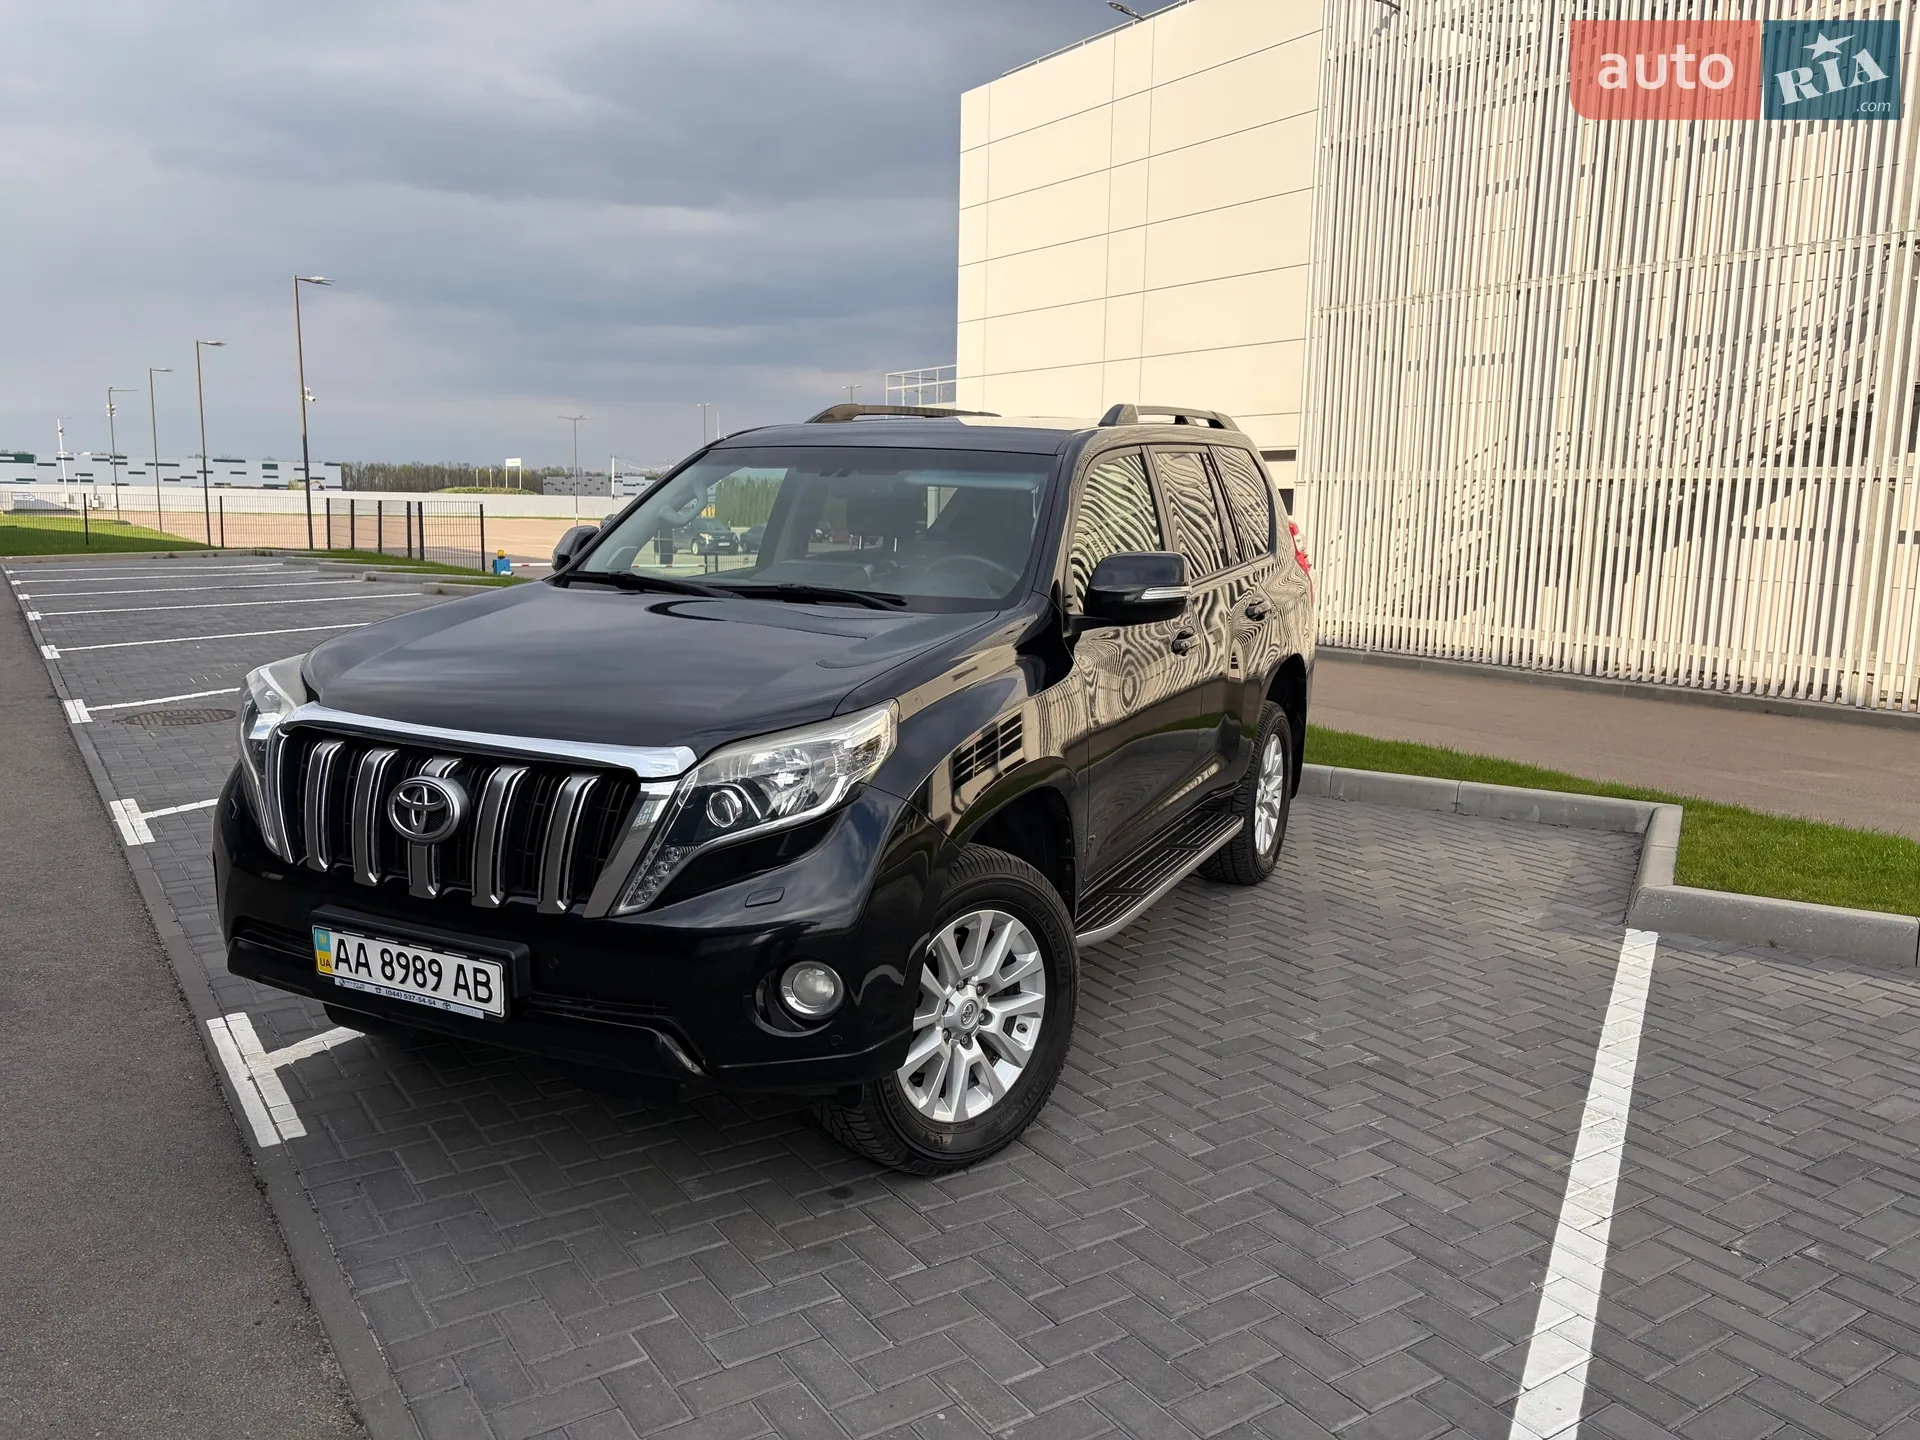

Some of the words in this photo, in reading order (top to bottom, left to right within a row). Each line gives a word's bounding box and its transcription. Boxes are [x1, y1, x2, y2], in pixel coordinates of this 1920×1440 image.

[319, 957, 332, 969] UA
[334, 938, 373, 978] AA
[380, 947, 443, 992] 8989
[453, 963, 493, 1004] AB
[385, 989, 402, 998] (044)
